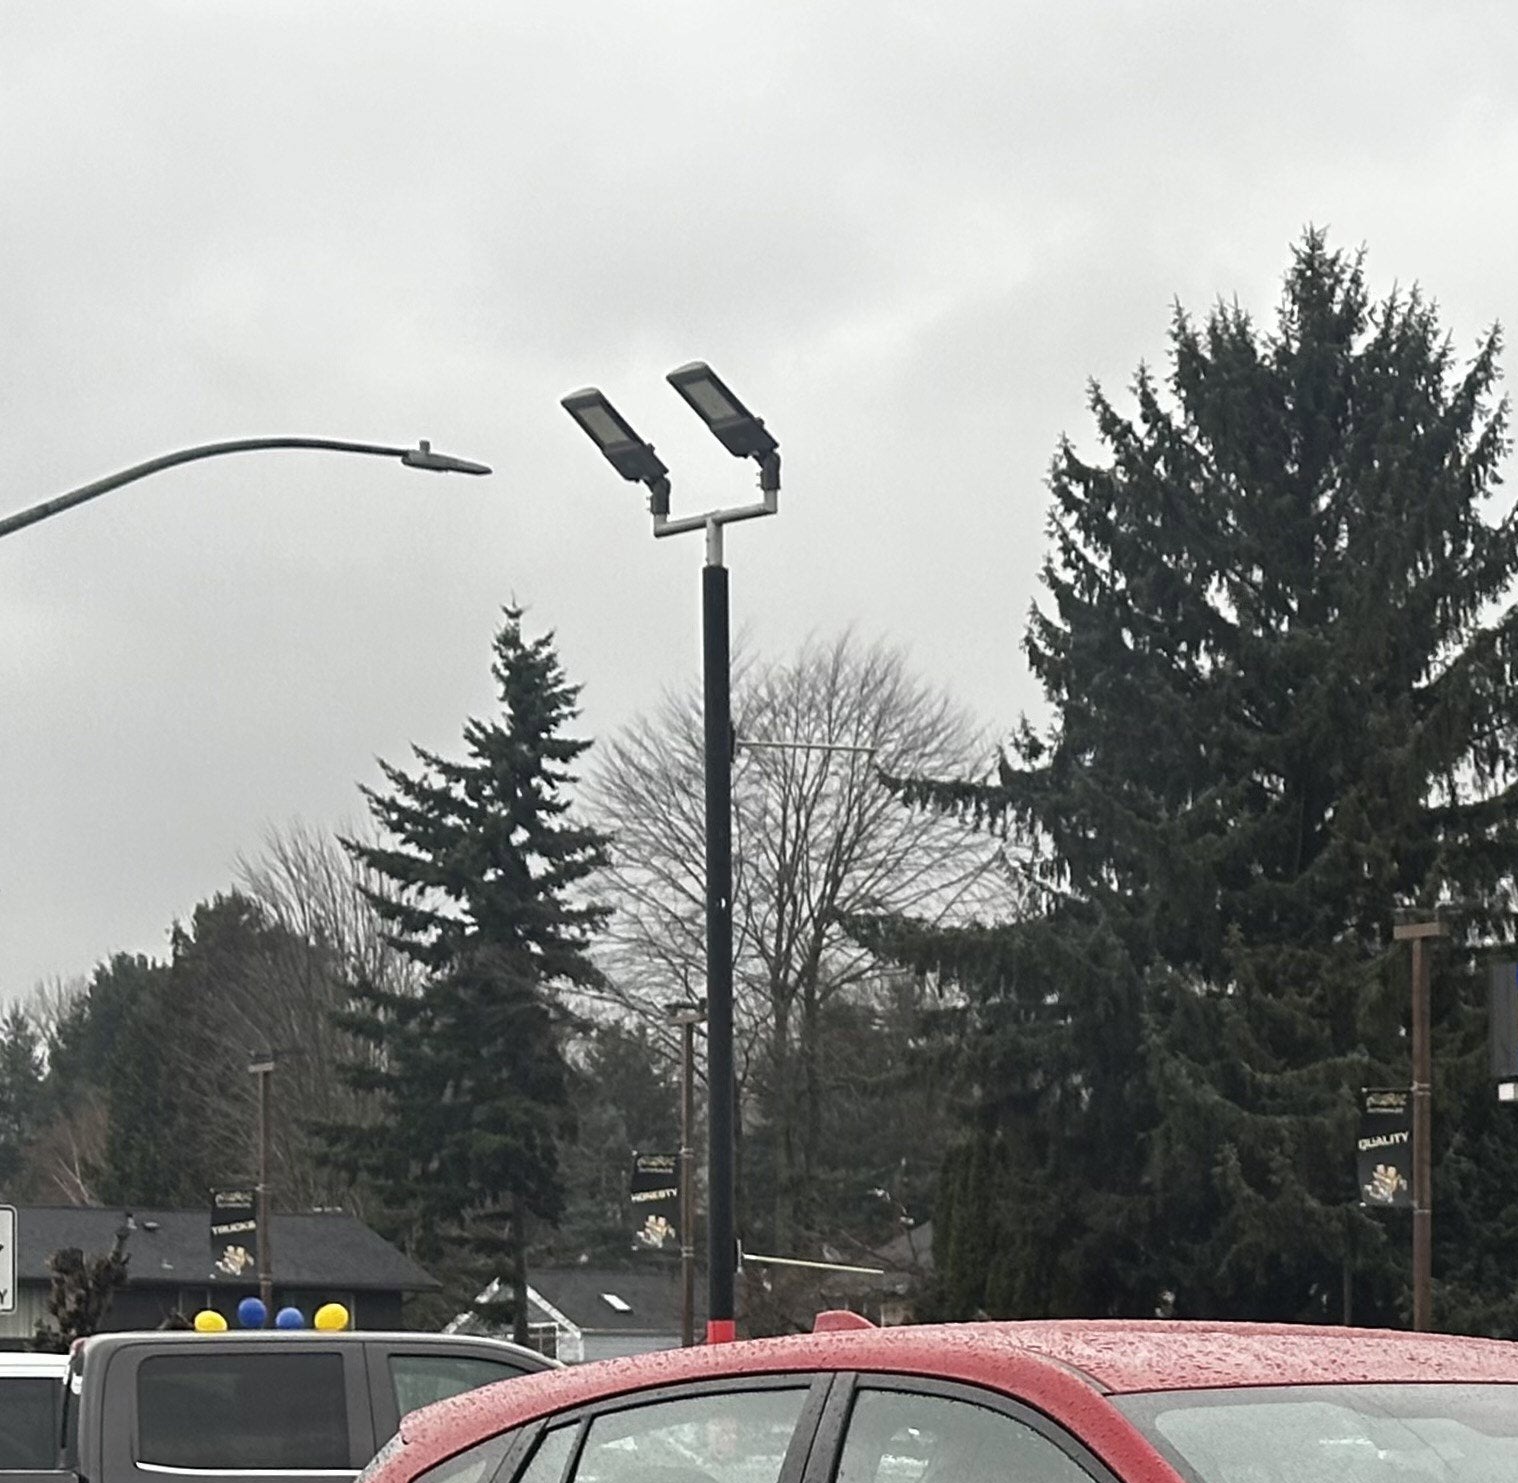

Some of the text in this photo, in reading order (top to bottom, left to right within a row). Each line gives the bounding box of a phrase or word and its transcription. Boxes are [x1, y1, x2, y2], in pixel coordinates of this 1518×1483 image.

[1358, 1131, 1409, 1151] QUALITY
[630, 1188, 678, 1203] HONESTY
[211, 1220, 257, 1235] TRUCKS
